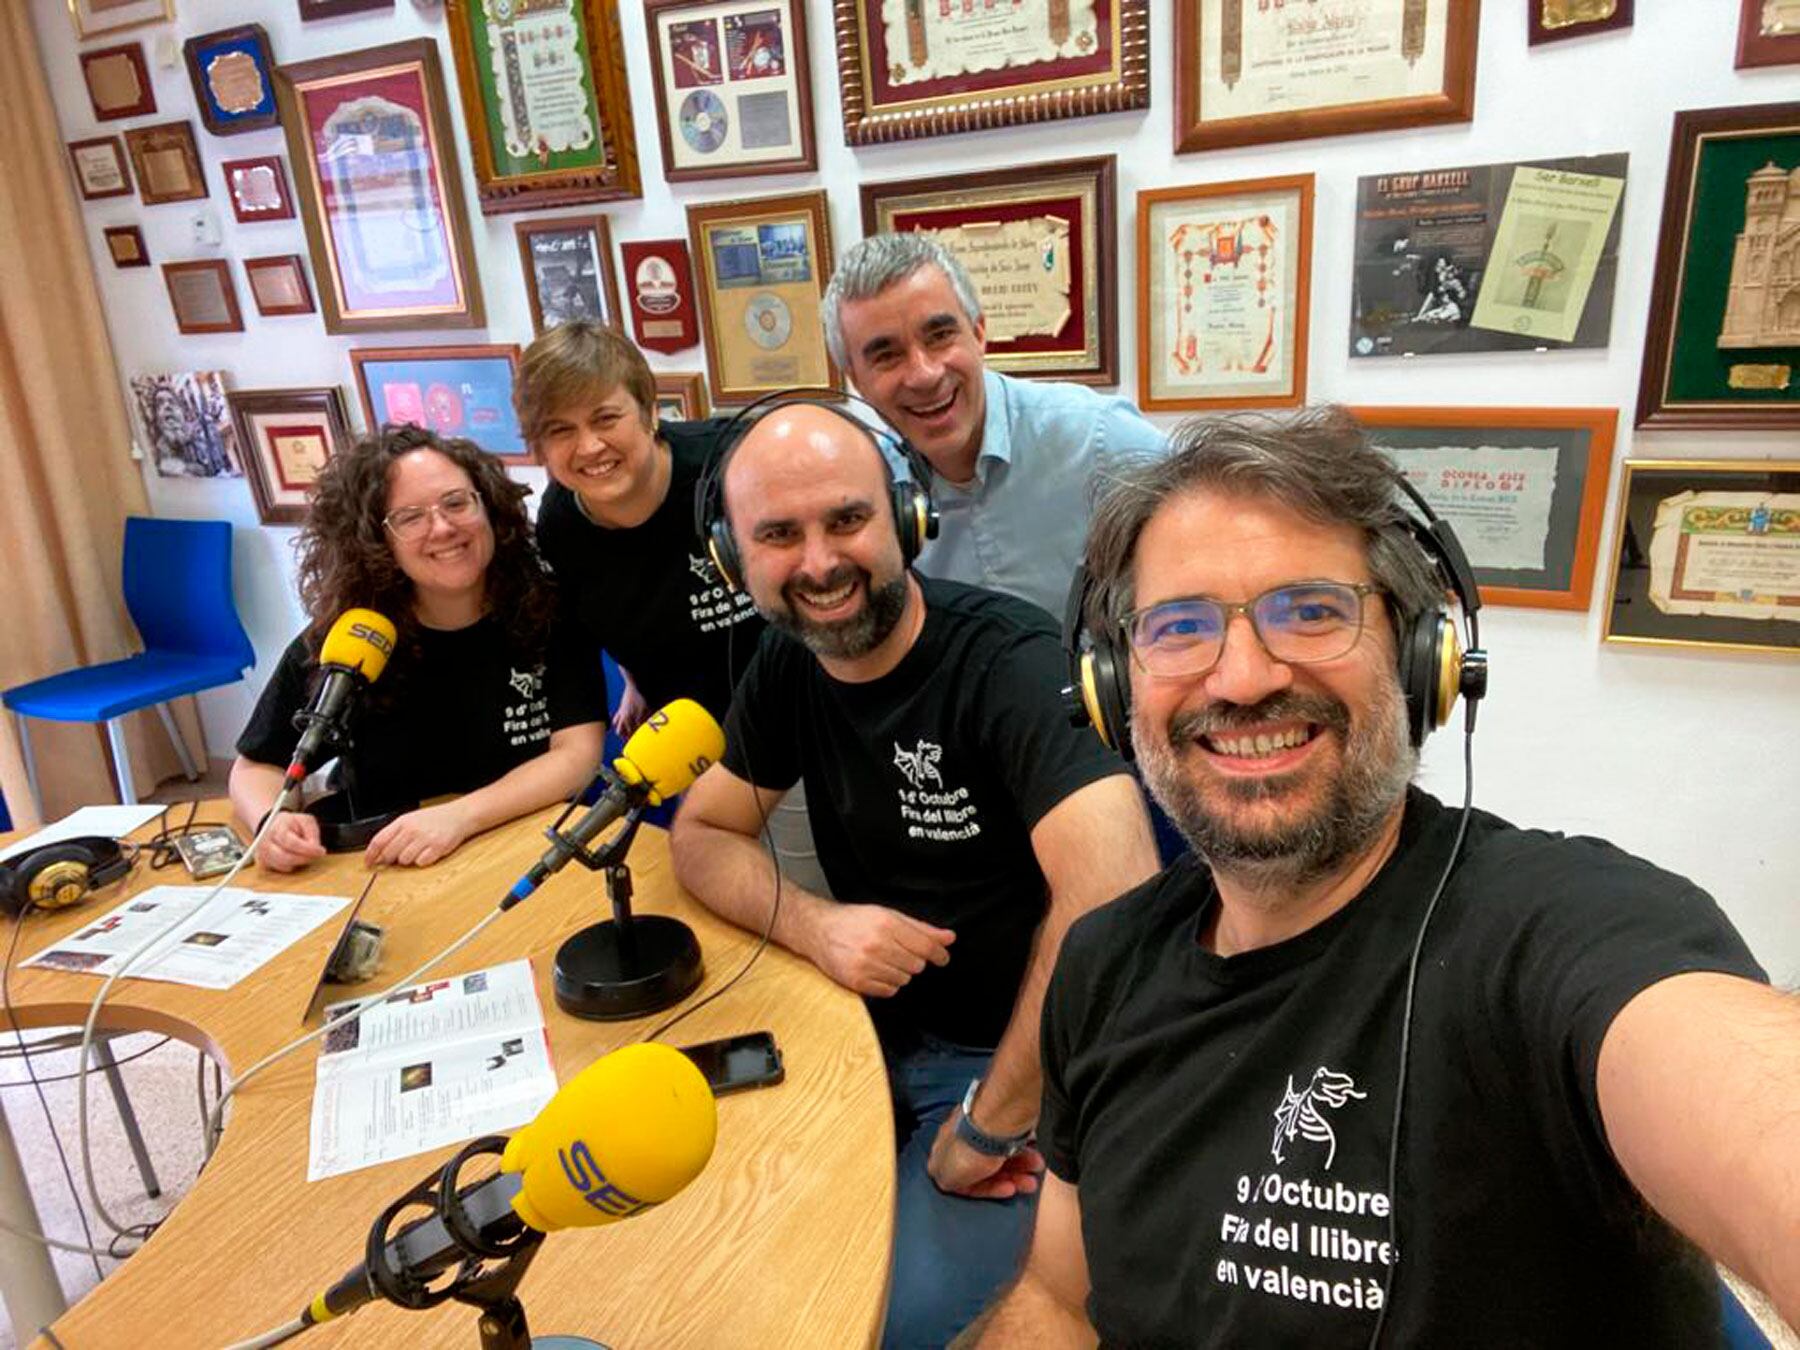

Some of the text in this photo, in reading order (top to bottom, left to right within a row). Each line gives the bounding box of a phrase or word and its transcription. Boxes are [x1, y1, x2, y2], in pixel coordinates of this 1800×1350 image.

[715, 601, 731, 614] de
[700, 621, 716, 633] en
[510, 734, 527, 746] en
[922, 808, 943, 823] del
[908, 825, 925, 838] en
[557, 1140, 649, 1219] SE
[1236, 1174, 1250, 1204] 9
[1253, 1217, 1299, 1253] del
[1310, 1224, 1400, 1266] llibre
[1216, 1258, 1386, 1312] en valencià
